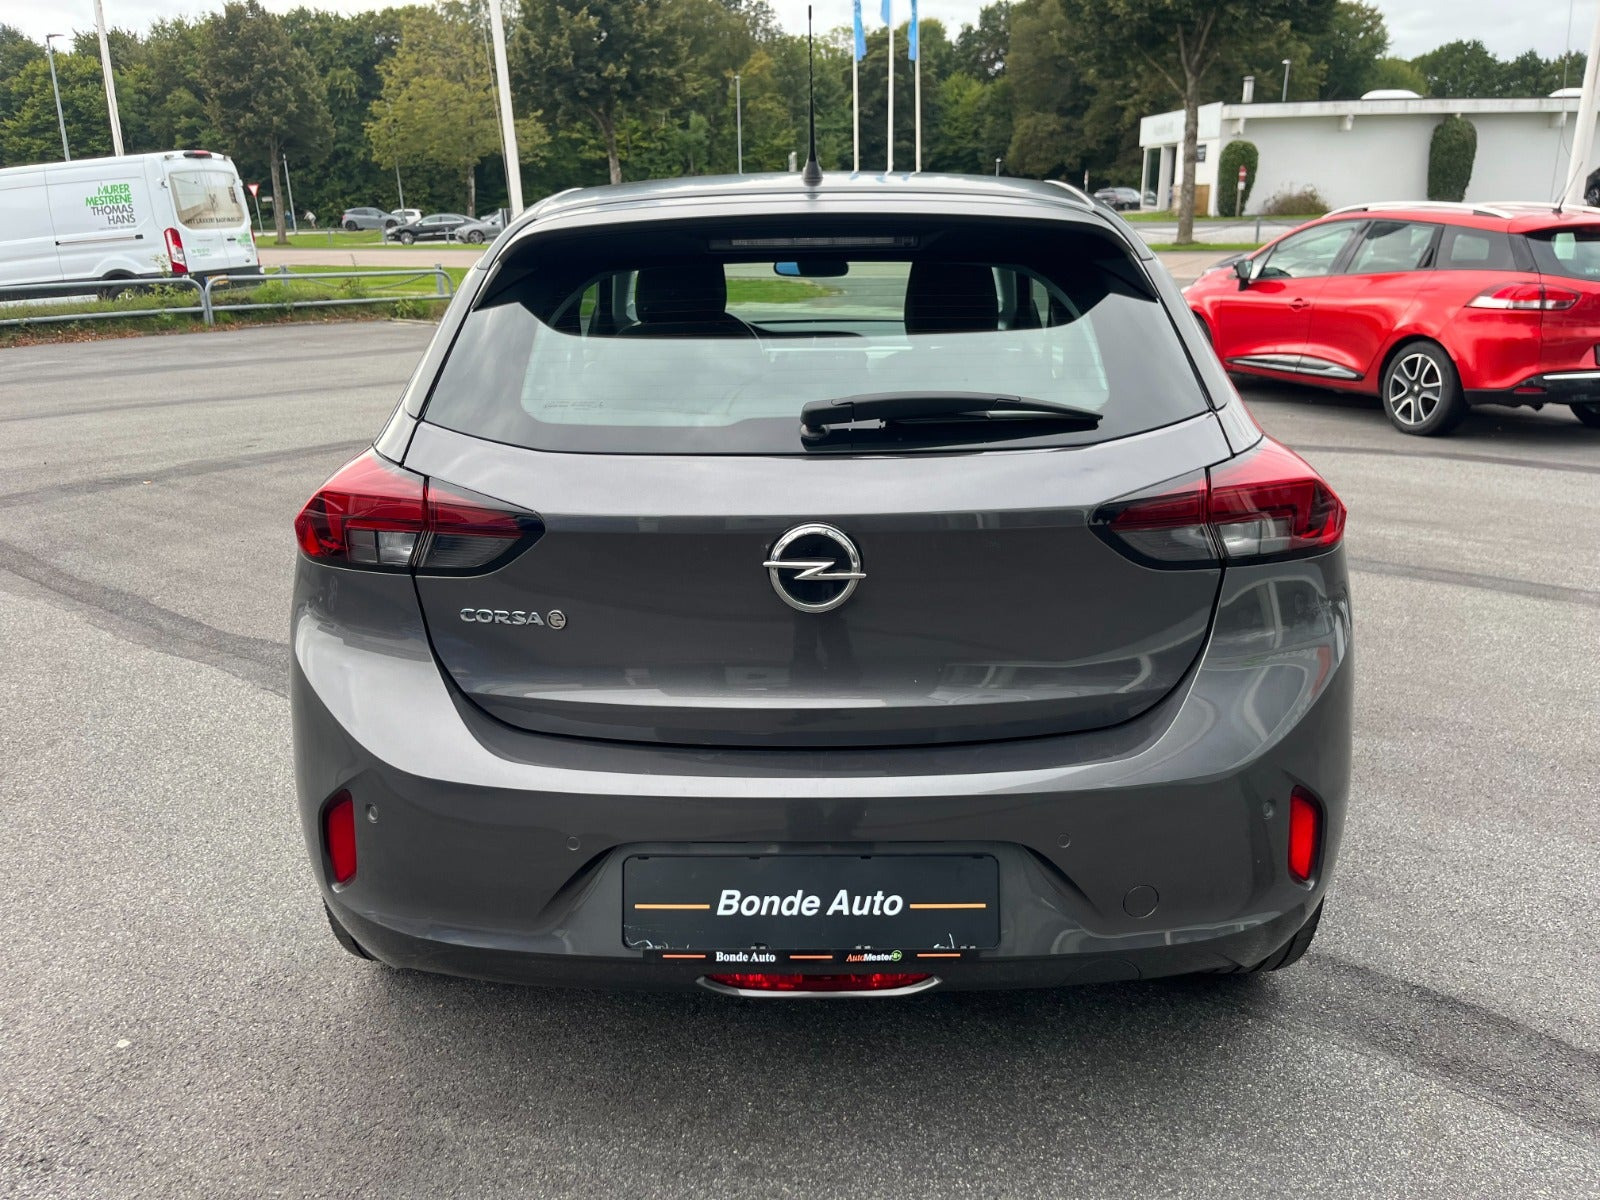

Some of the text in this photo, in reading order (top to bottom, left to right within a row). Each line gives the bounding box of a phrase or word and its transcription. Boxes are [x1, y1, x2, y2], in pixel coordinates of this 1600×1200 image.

[97, 183, 130, 195] MURER
[85, 194, 133, 206] MESTRENE
[91, 204, 134, 216] THOMAS
[107, 214, 136, 225] HANS
[460, 608, 545, 626] CORSA
[716, 889, 904, 917] Bonde Auto
[715, 951, 776, 963] Bonde Auto
